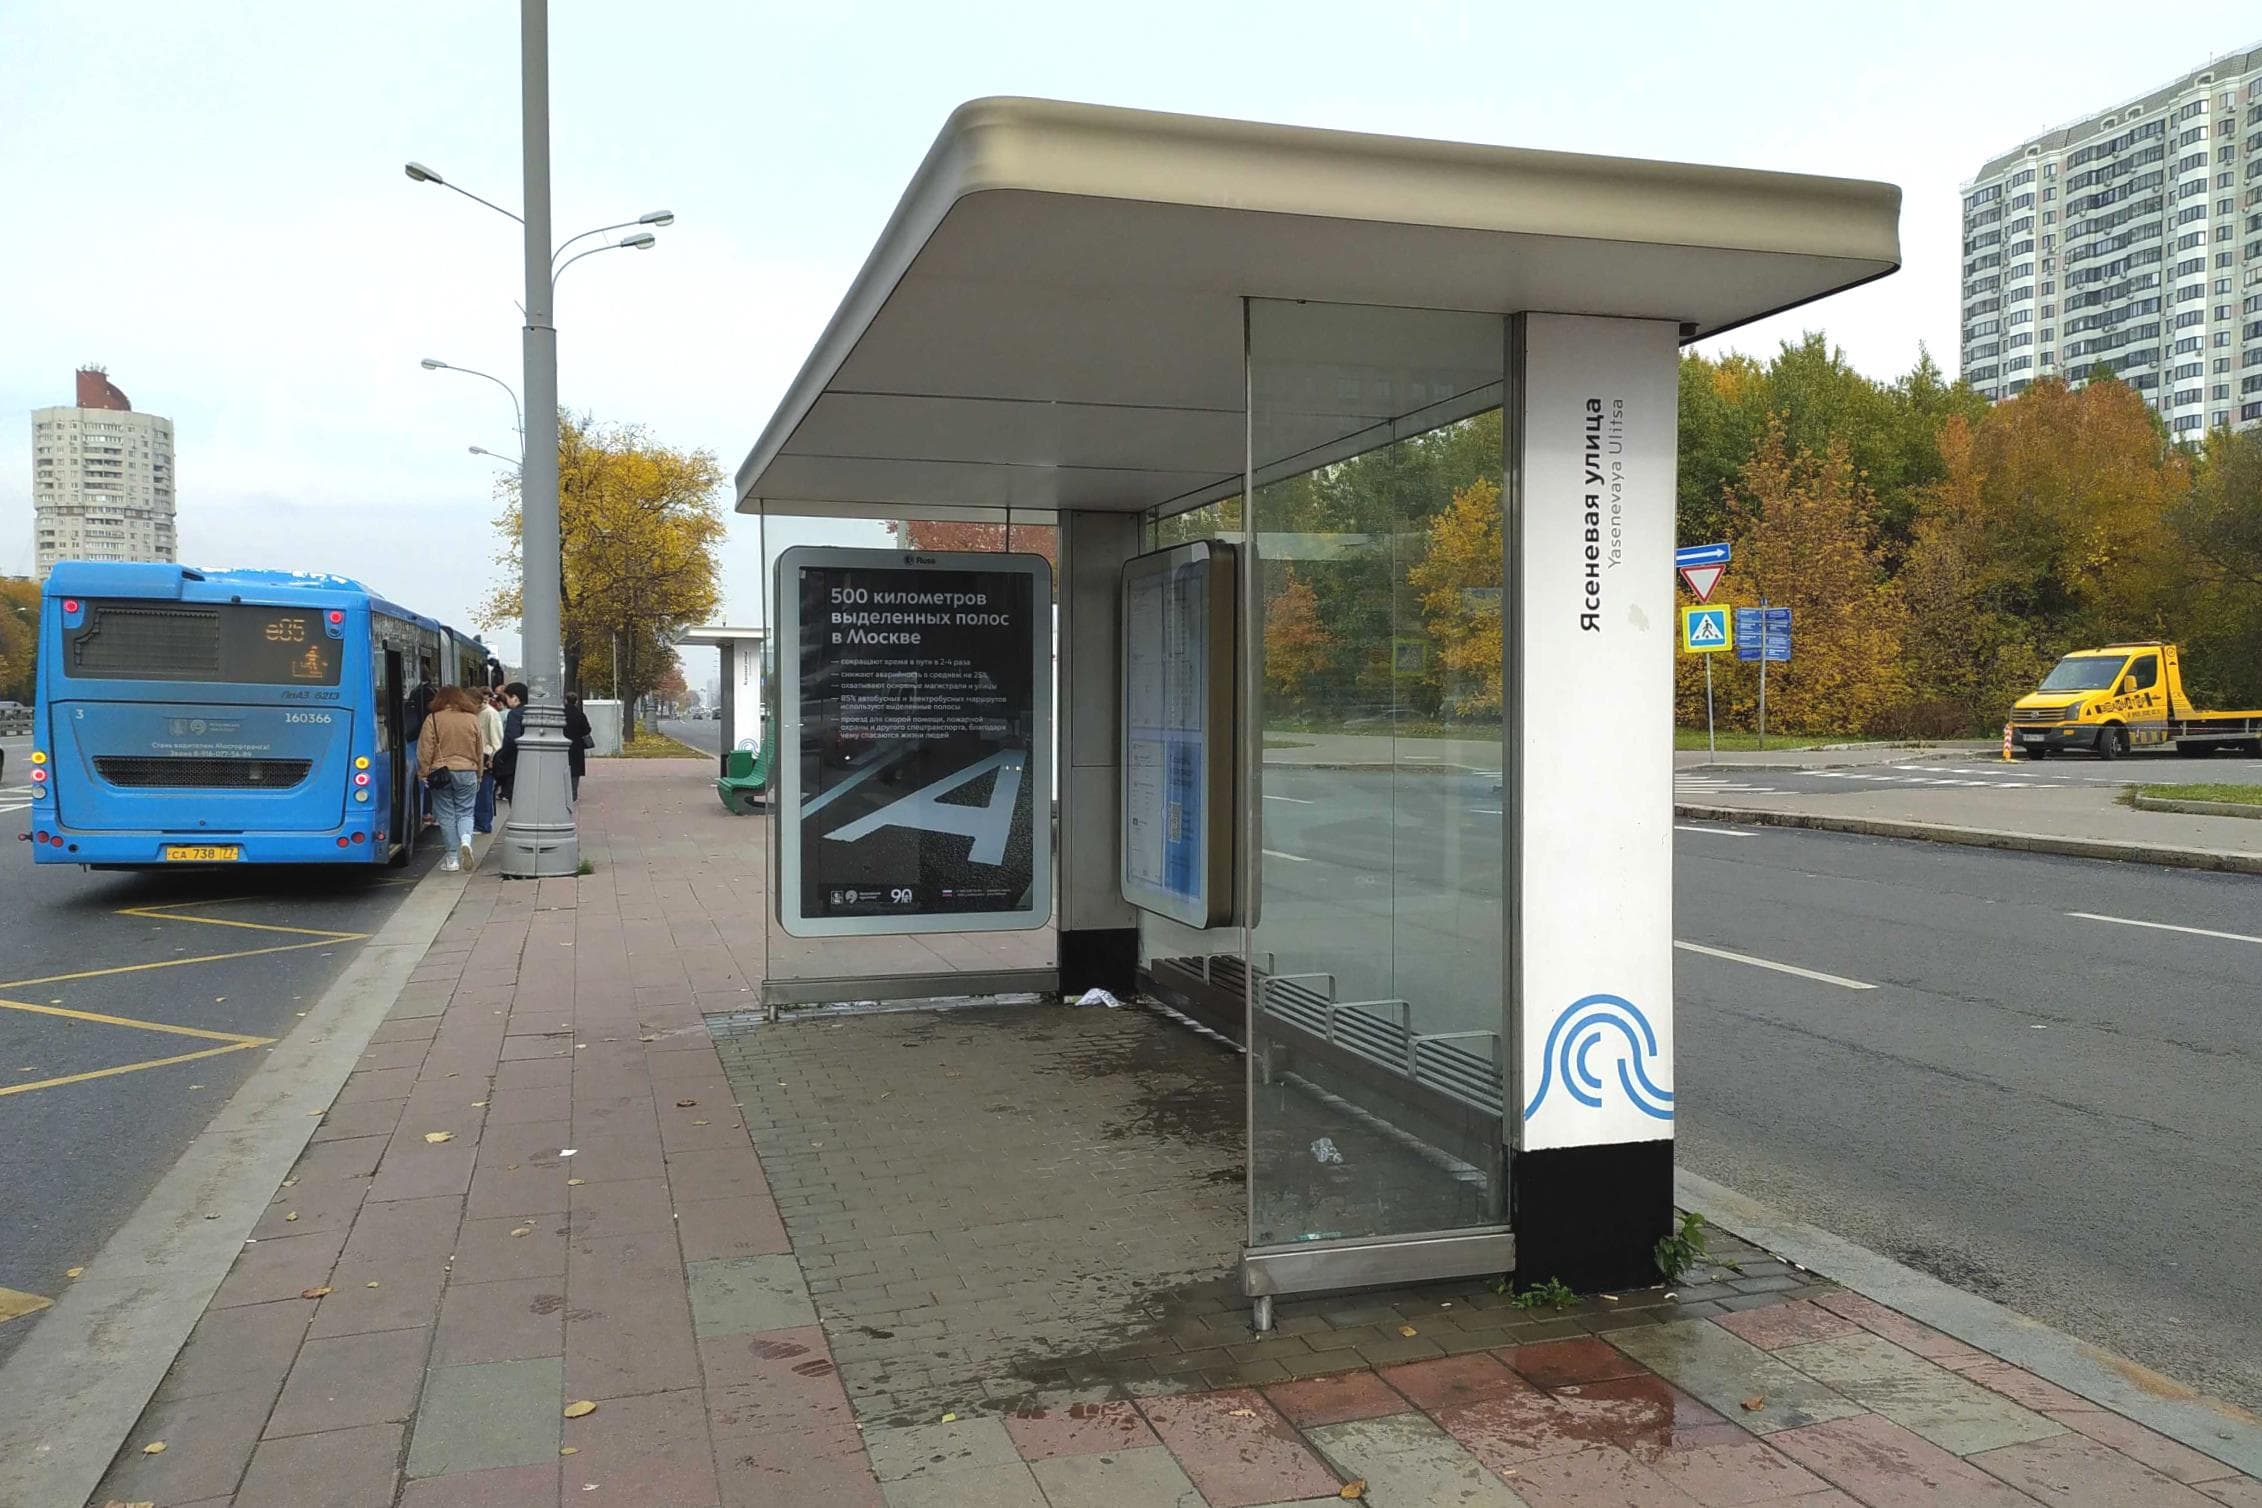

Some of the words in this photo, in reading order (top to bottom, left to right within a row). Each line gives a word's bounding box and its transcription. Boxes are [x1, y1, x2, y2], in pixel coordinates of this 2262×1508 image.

[1608, 400, 1623, 454] Ulitsa
[1586, 398, 1604, 485] улица
[1608, 462, 1624, 569] Yasenevaya
[1580, 494, 1600, 632] Ясеневая
[831, 588, 868, 604] 500
[874, 592, 987, 608] километров
[831, 612, 950, 626] выделенных
[956, 614, 1010, 626] полос
[832, 632, 842, 644] в
[847, 629, 921, 644] Москве
[76, 708, 84, 720] 3
[285, 712, 332, 724] 160366
[172, 850, 187, 858] СА
[192, 848, 215, 859] 738
